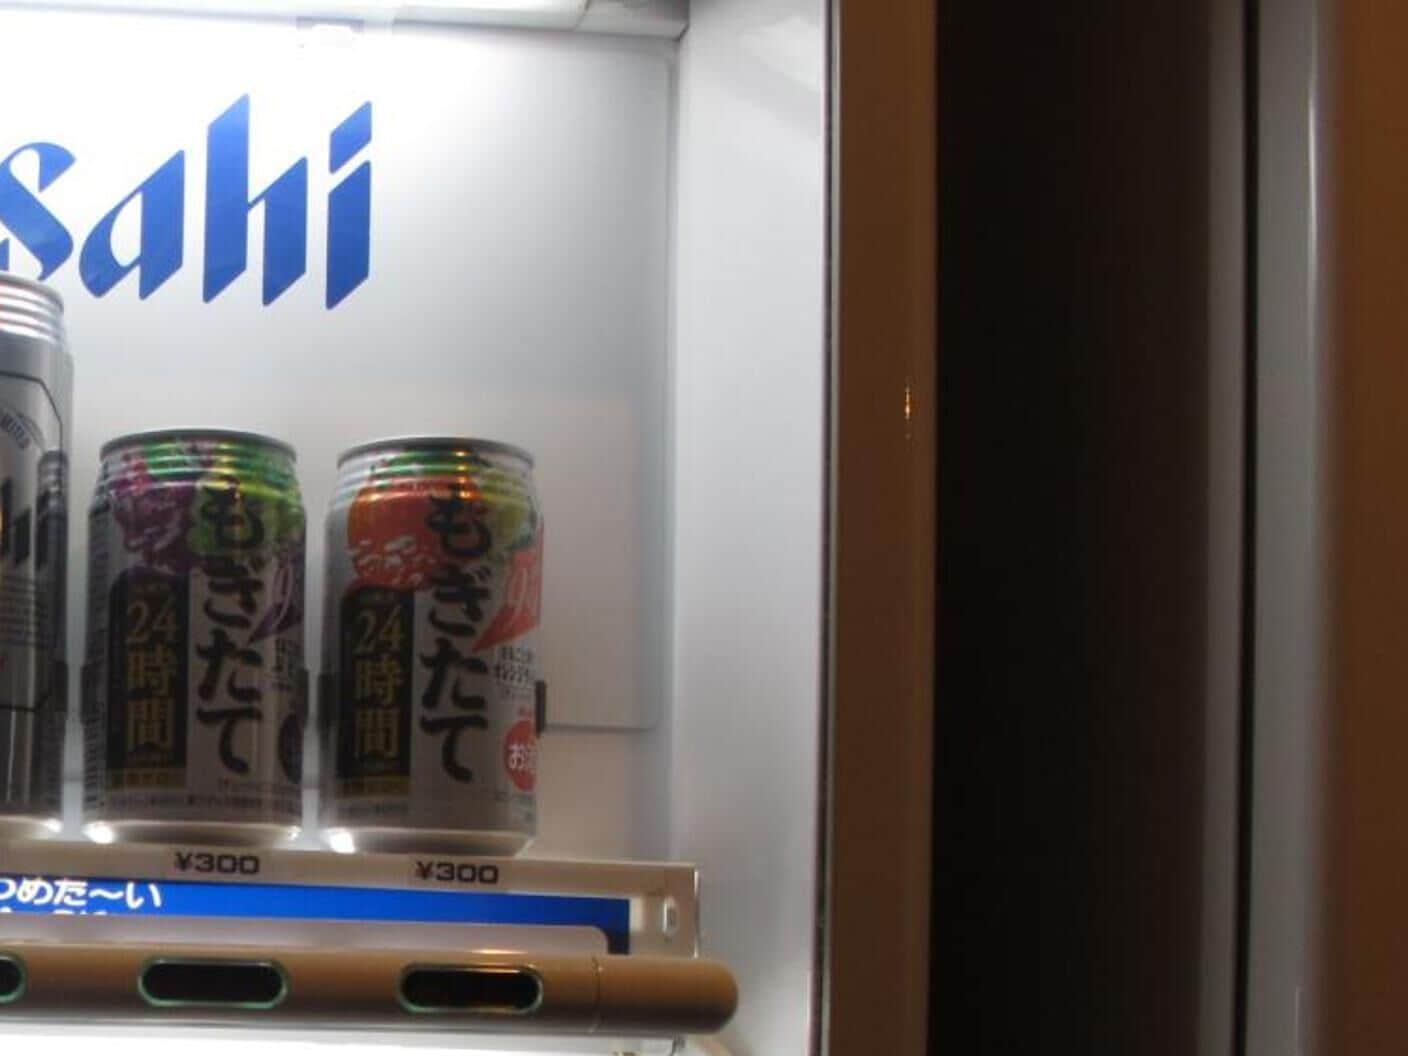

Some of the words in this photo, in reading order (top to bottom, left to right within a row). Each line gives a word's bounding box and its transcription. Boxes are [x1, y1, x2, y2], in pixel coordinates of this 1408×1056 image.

[125, 598, 182, 756] 24時間
[195, 480, 267, 775] もぎたて
[353, 605, 408, 761] 24時間
[419, 485, 491, 784] もぎたて
[174, 852, 261, 876] ¥300
[414, 860, 500, 885] ¥300
